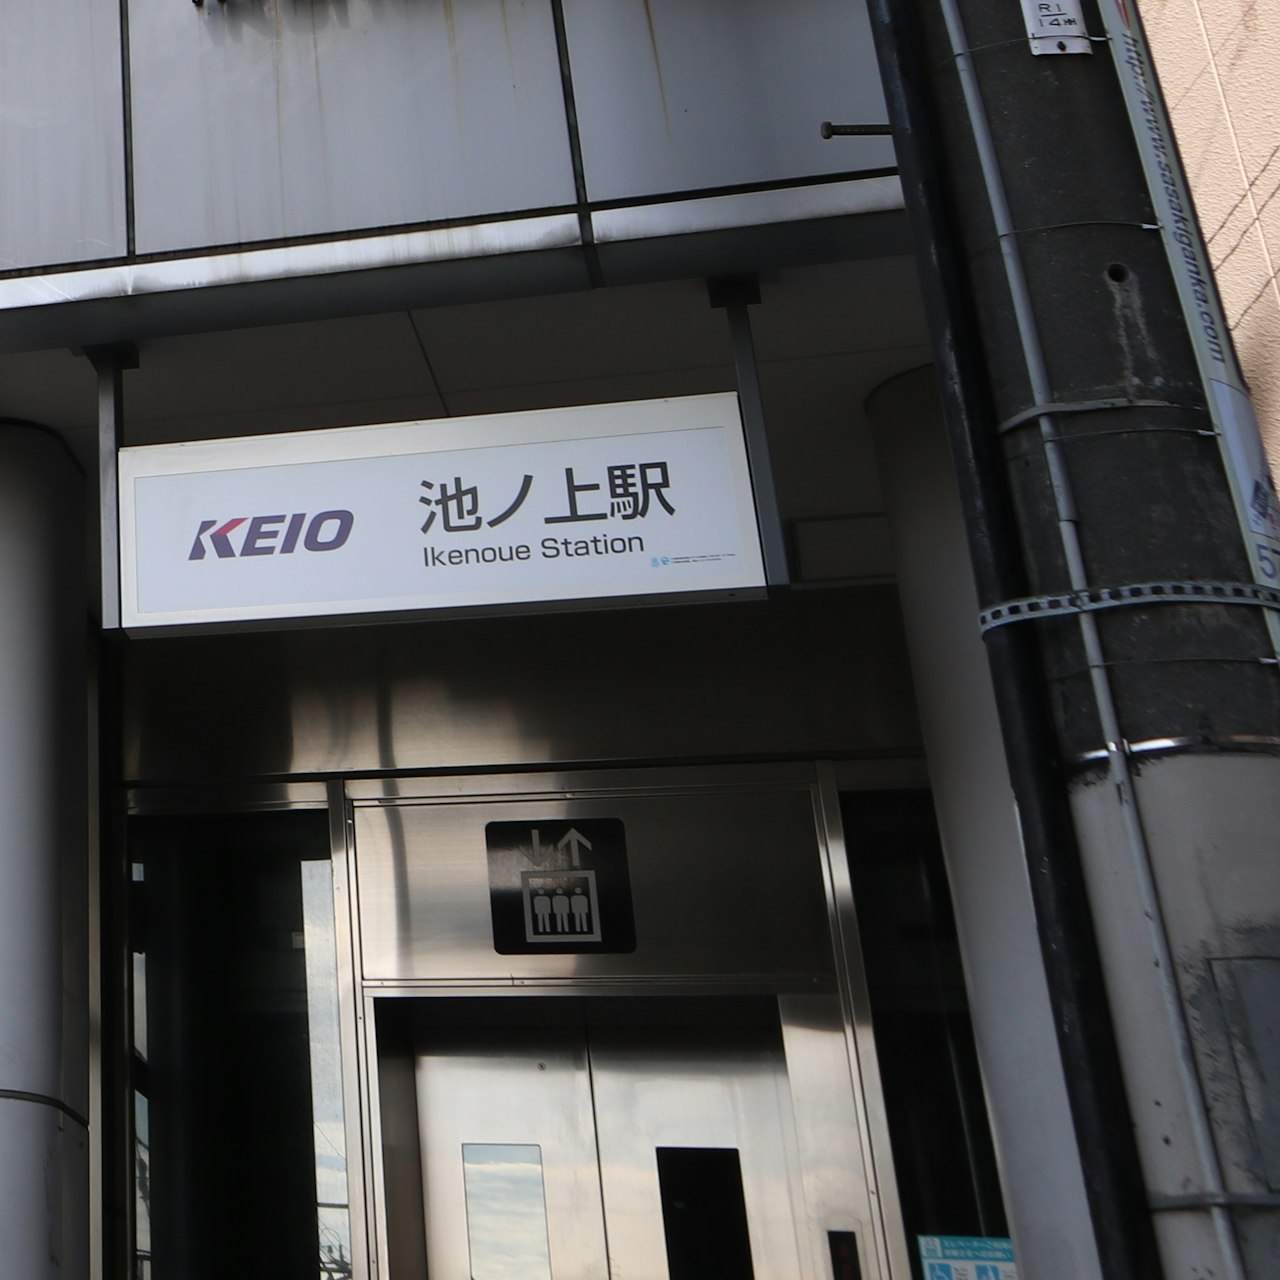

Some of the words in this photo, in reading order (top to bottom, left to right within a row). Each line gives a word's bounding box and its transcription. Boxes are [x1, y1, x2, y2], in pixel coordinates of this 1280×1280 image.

[419, 460, 677, 535] 池ノ上駅
[187, 509, 354, 562] KEIO
[423, 542, 531, 568] Ikenoue
[541, 533, 645, 560] Station
[1255, 543, 1280, 578] 5
